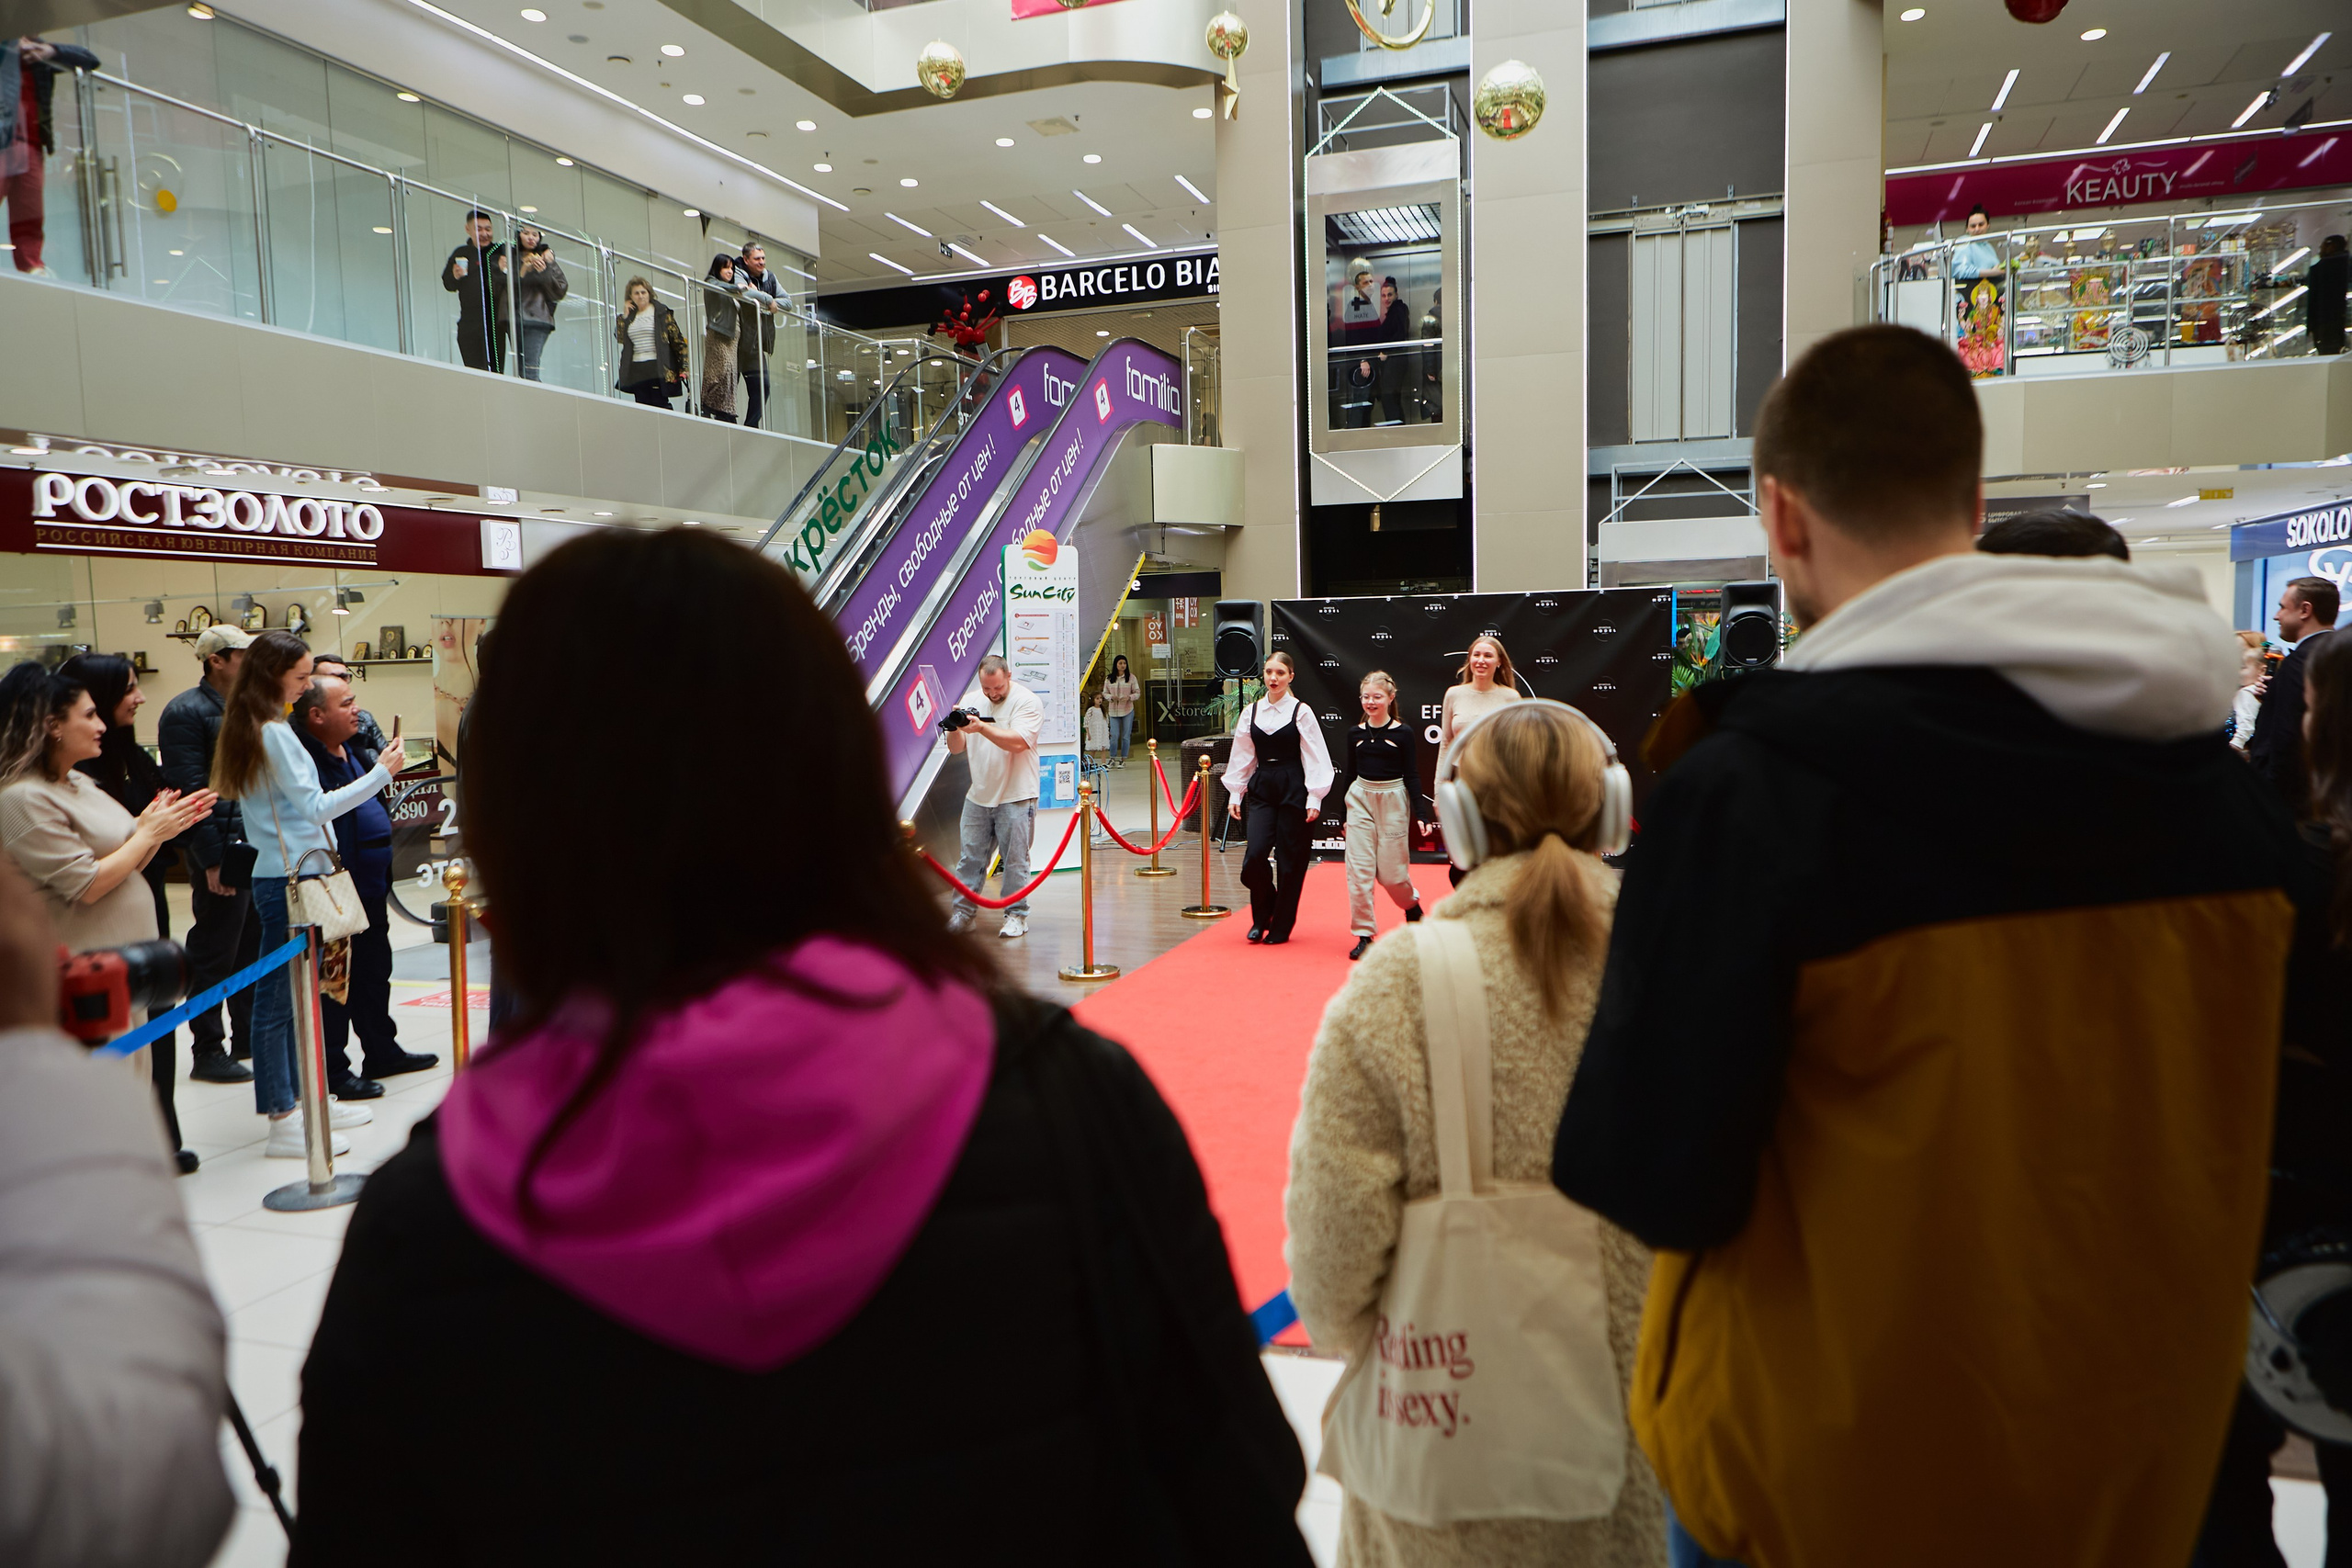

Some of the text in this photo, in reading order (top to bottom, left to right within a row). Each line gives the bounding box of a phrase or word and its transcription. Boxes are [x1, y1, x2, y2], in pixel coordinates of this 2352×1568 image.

[2066, 170, 2178, 205] KEAUTY
[1041, 263, 1165, 300] BARCELO
[1125, 355, 1182, 416] familia
[31, 472, 385, 541] РОСТЗОЛОТО
[36, 527, 378, 561] РОССИЙСКАЯ ЮВЕЛИРНАЯ КОМПАНИЯ
[899, 492, 960, 589] свободные
[957, 471, 973, 502] от
[2286, 506, 2352, 548] SOKOLO
[947, 580, 999, 663] Бренды,
[1049, 466, 1063, 496] от
[916, 690, 924, 710] 4
[437, 797, 459, 836] 2
